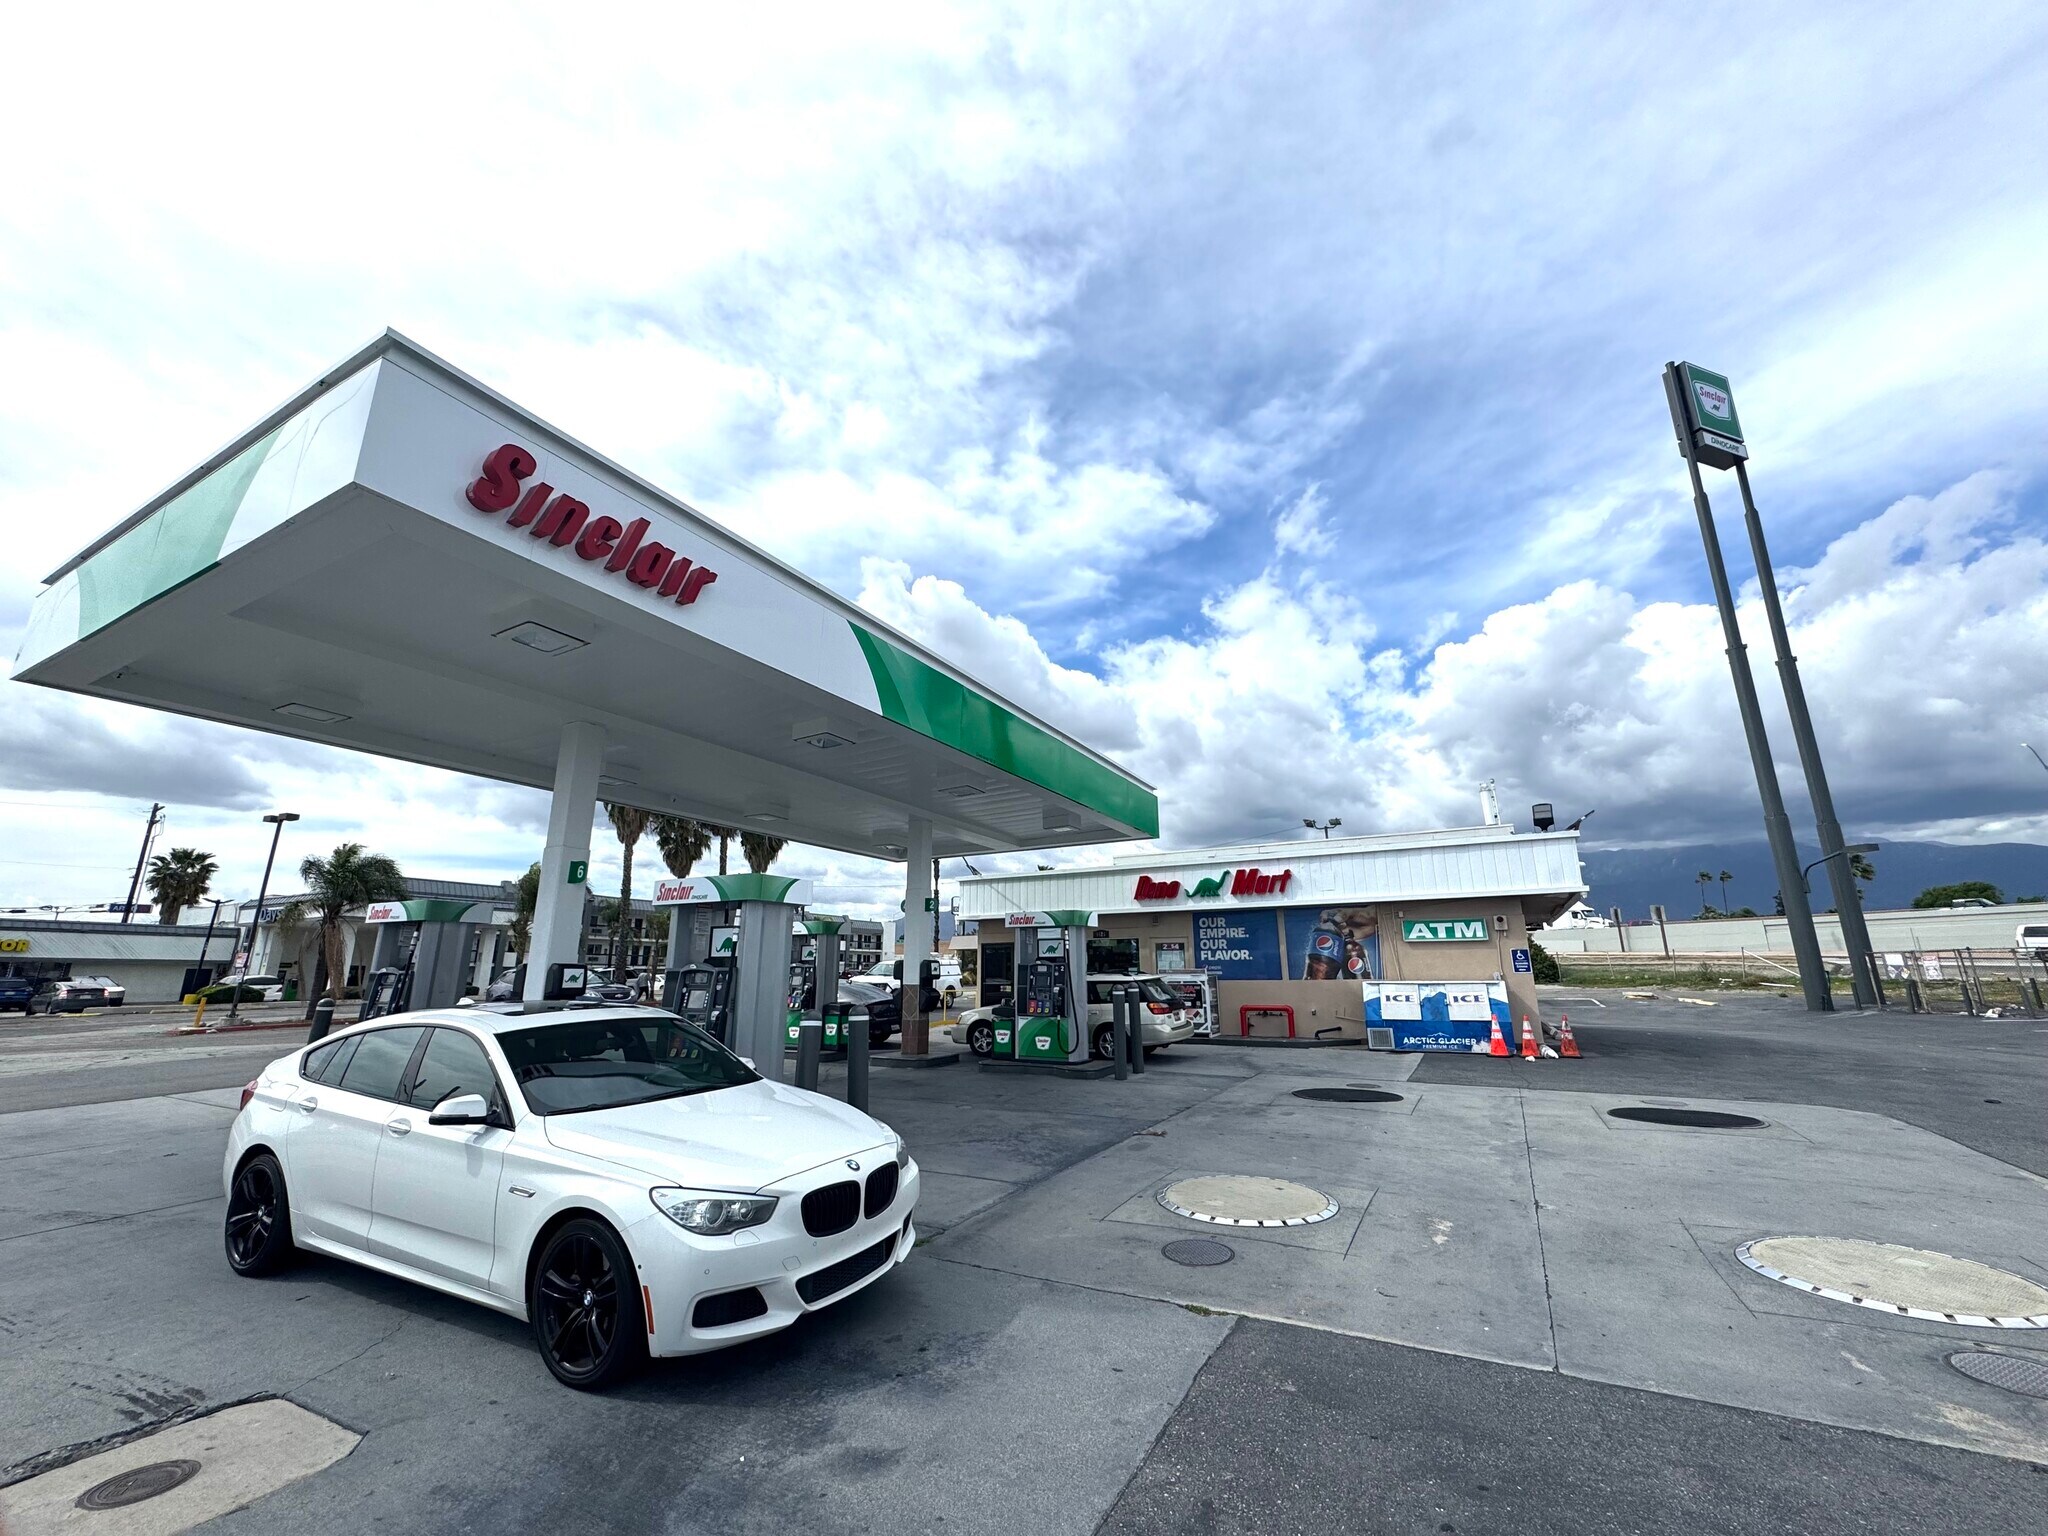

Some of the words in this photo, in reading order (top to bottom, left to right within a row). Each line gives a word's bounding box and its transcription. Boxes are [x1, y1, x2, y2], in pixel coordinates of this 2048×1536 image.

[1699, 386, 1726, 404] Sinclair
[465, 443, 719, 606] Sinclair
[577, 865, 584, 879] 6
[1230, 868, 1292, 895] Mart
[656, 881, 694, 902] Sinclair
[929, 900, 935, 909] 2
[368, 905, 393, 920] Sinclair
[1008, 914, 1035, 925] Sinclair
[1198, 917, 1226, 928] OUR
[1199, 927, 1249, 939] EMPIRE.
[1408, 921, 1484, 939] ATM
[0, 939, 30, 952] OR
[1200, 939, 1228, 950] OUR
[1200, 949, 1254, 961] FLAVOR.
[1385, 994, 1415, 1003] ICE
[1452, 994, 1486, 1003] ICE
[1403, 1036, 1436, 1045] ARCTIC
[1438, 1037, 1477, 1046] GLACIER
